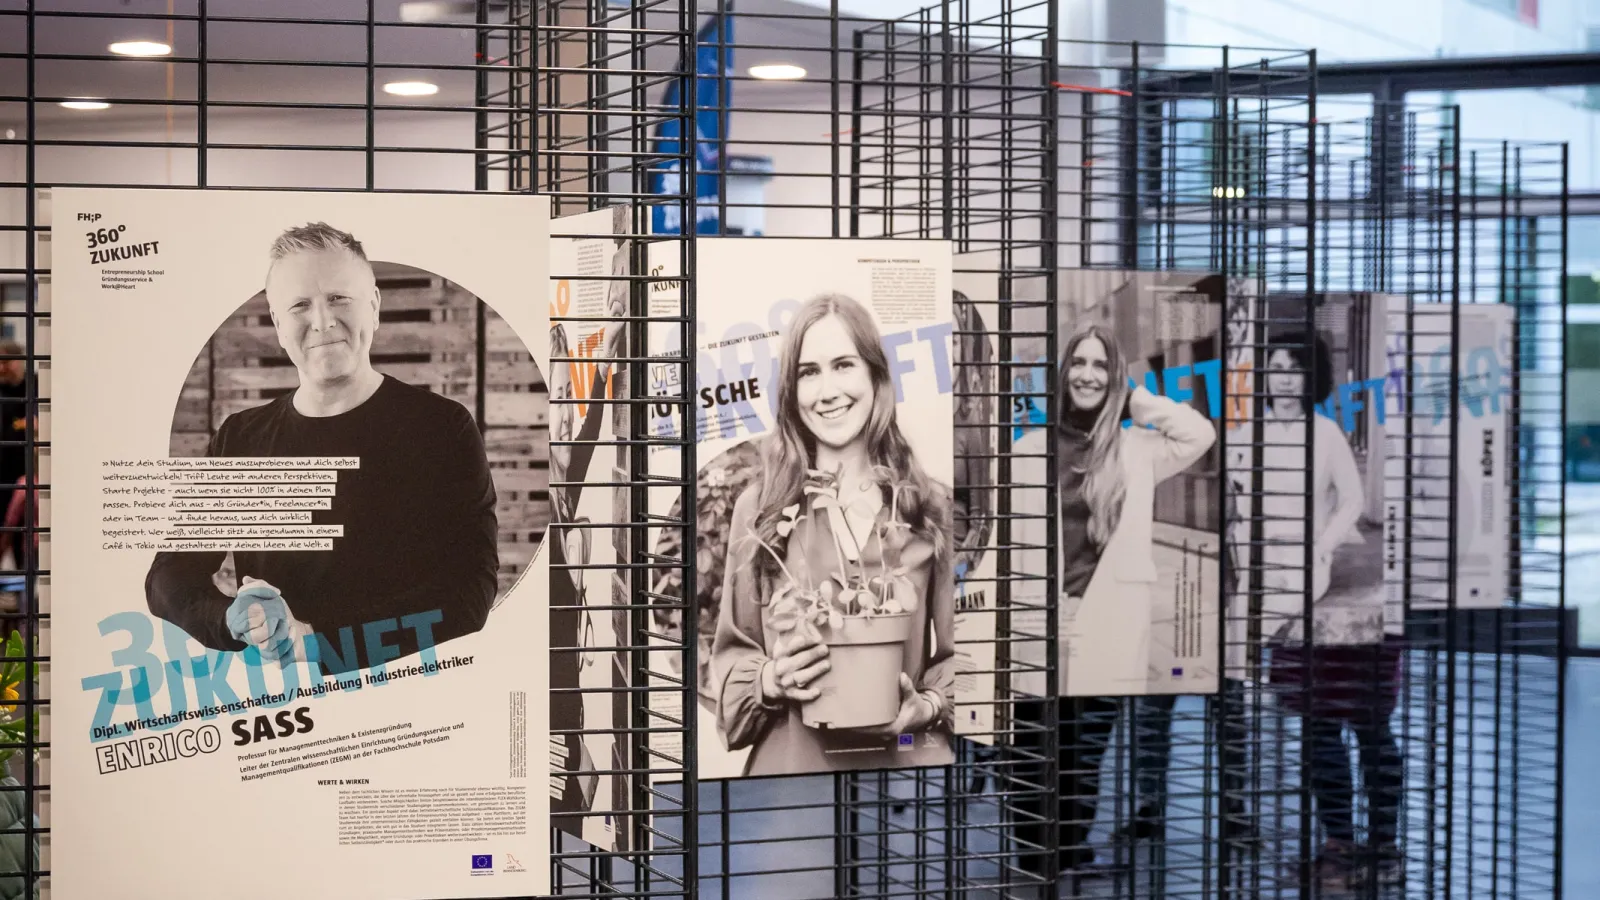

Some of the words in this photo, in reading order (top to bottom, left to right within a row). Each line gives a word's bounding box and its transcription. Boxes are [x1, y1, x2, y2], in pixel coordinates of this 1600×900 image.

[77, 213, 102, 223] FH;P
[86, 224, 126, 248] 360°
[90, 241, 159, 264] ZUKUNFT
[719, 337, 746, 347] ZUKUNFT
[748, 331, 780, 342] GESTALTEN
[136, 459, 154, 467] dein
[156, 459, 193, 468] Studium,
[209, 459, 233, 467] Neues
[235, 459, 294, 468] auszuprobieren
[314, 458, 332, 466] dich
[334, 458, 357, 466] selbst
[102, 472, 182, 481] weiterzuentwickeln!
[283, 472, 334, 481] Perspektiven.
[133, 486, 166, 496] Projekte
[174, 486, 196, 494] auch
[133, 500, 166, 508] Probiere
[168, 500, 187, 508] dich
[212, 500, 225, 508] als
[209, 513, 240, 522] heraus,
[260, 513, 277, 521] dich
[279, 513, 310, 521] wirklich
[102, 529, 147, 538] begeistert.
[166, 528, 187, 537] weiß,
[187, 528, 225, 536] vielleicht
[260, 527, 305, 536] irgendwann
[102, 542, 123, 550] Café
[175, 541, 217, 551] gestaltest
[219, 541, 231, 549] mit
[81, 608, 443, 743] ZUKUNFT
[93, 725, 122, 739] Dipl.
[124, 693, 286, 732] Wirtschaftswissenschaften
[288, 688, 294, 702] /
[296, 677, 362, 698] Ausbildung
[365, 655, 474, 684] Industrieelektriker
[95, 724, 221, 775] ENRICO
[231, 706, 314, 746] SASS
[237, 752, 267, 761] Professur
[268, 748, 277, 756] für
[279, 734, 350, 753] Managementtechniken
[358, 722, 412, 738] Existenzgründung
[239, 764, 257, 773] Leiter
[271, 757, 301, 767] Zentralen
[302, 745, 360, 760] wissenschaftlichen
[361, 736, 396, 748] Einrichtung
[397, 726, 451, 741] Gründungsservice
[452, 722, 464, 730] und
[241, 760, 329, 781] Managementqualifikationen
[330, 754, 352, 764] (ZEGM)
[374, 741, 422, 755] Fachhochschule
[423, 735, 450, 745] Potsdam
